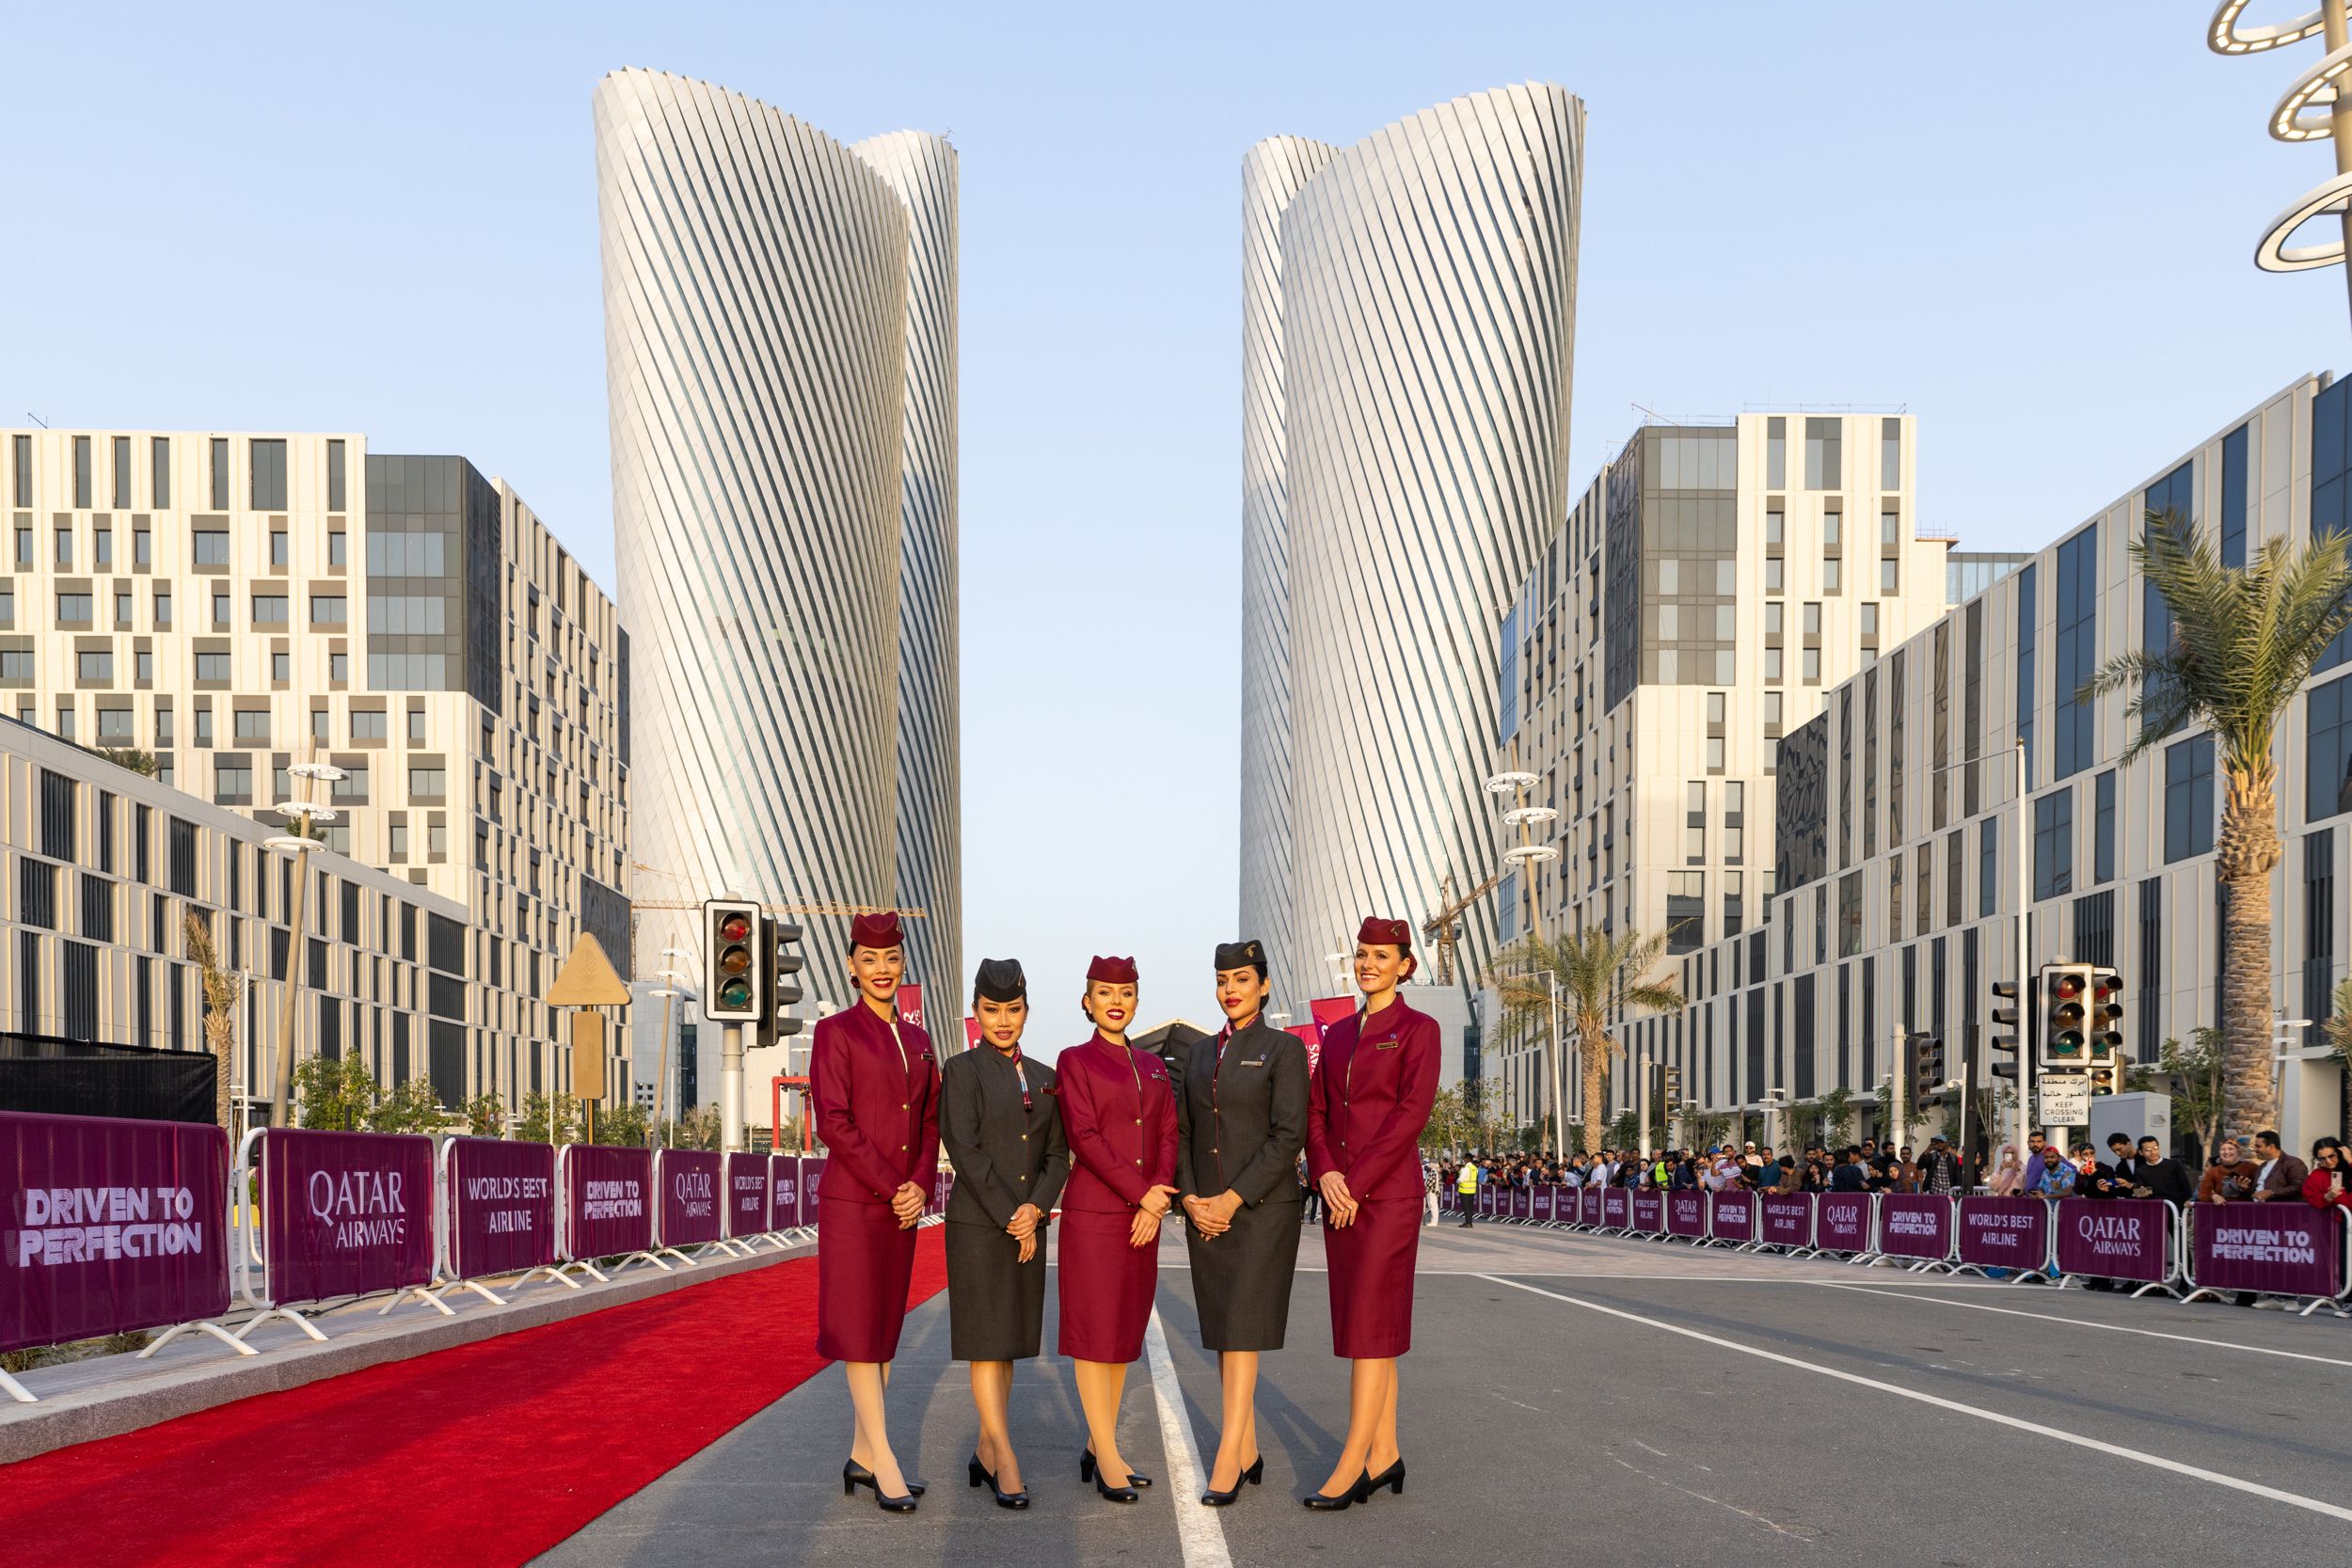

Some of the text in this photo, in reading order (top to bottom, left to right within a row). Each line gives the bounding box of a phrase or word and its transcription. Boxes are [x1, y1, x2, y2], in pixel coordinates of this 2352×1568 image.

[468, 1177, 548, 1200] WORLD'S BEST
[586, 1180, 639, 1200] DRIVEN TO
[675, 1172, 712, 1205] QATAR
[735, 1176, 755, 1190] WORLD'S
[25, 1187, 194, 1226] DRIVEN TO
[310, 1170, 405, 1226] QATAR
[741, 1197, 759, 1211] AIRLINE
[1675, 1199, 1698, 1216] QATAR
[584, 1198, 642, 1220] PERFECTION
[685, 1200, 711, 1218] AIRWAYS
[1717, 1212, 1747, 1223] PERFECTION
[1718, 1204, 1746, 1214] DRIVEN TO
[1767, 1204, 1805, 1216] WORLD'S BEST
[1826, 1205, 1858, 1226] QATAR
[1891, 1212, 1936, 1224] DRIVEN TO
[488, 1210, 532, 1234] AIRLINE
[1773, 1219, 1795, 1230] AIRLINE
[1834, 1223, 1857, 1235] AIRWAYS
[1889, 1221, 1937, 1236] PERFECTION
[1968, 1213, 2034, 1229] WORLD'S BEST
[2078, 1215, 2141, 1243] QATAR
[336, 1218, 405, 1248] AIRWAYS
[1981, 1231, 2018, 1246] AIRLINE
[2216, 1227, 2311, 1247] DRIVEN TO
[19, 1222, 202, 1268] PERFECTION
[2092, 1239, 2141, 1258] AIRWAYS
[2212, 1243, 2315, 1265] PERFECTION
